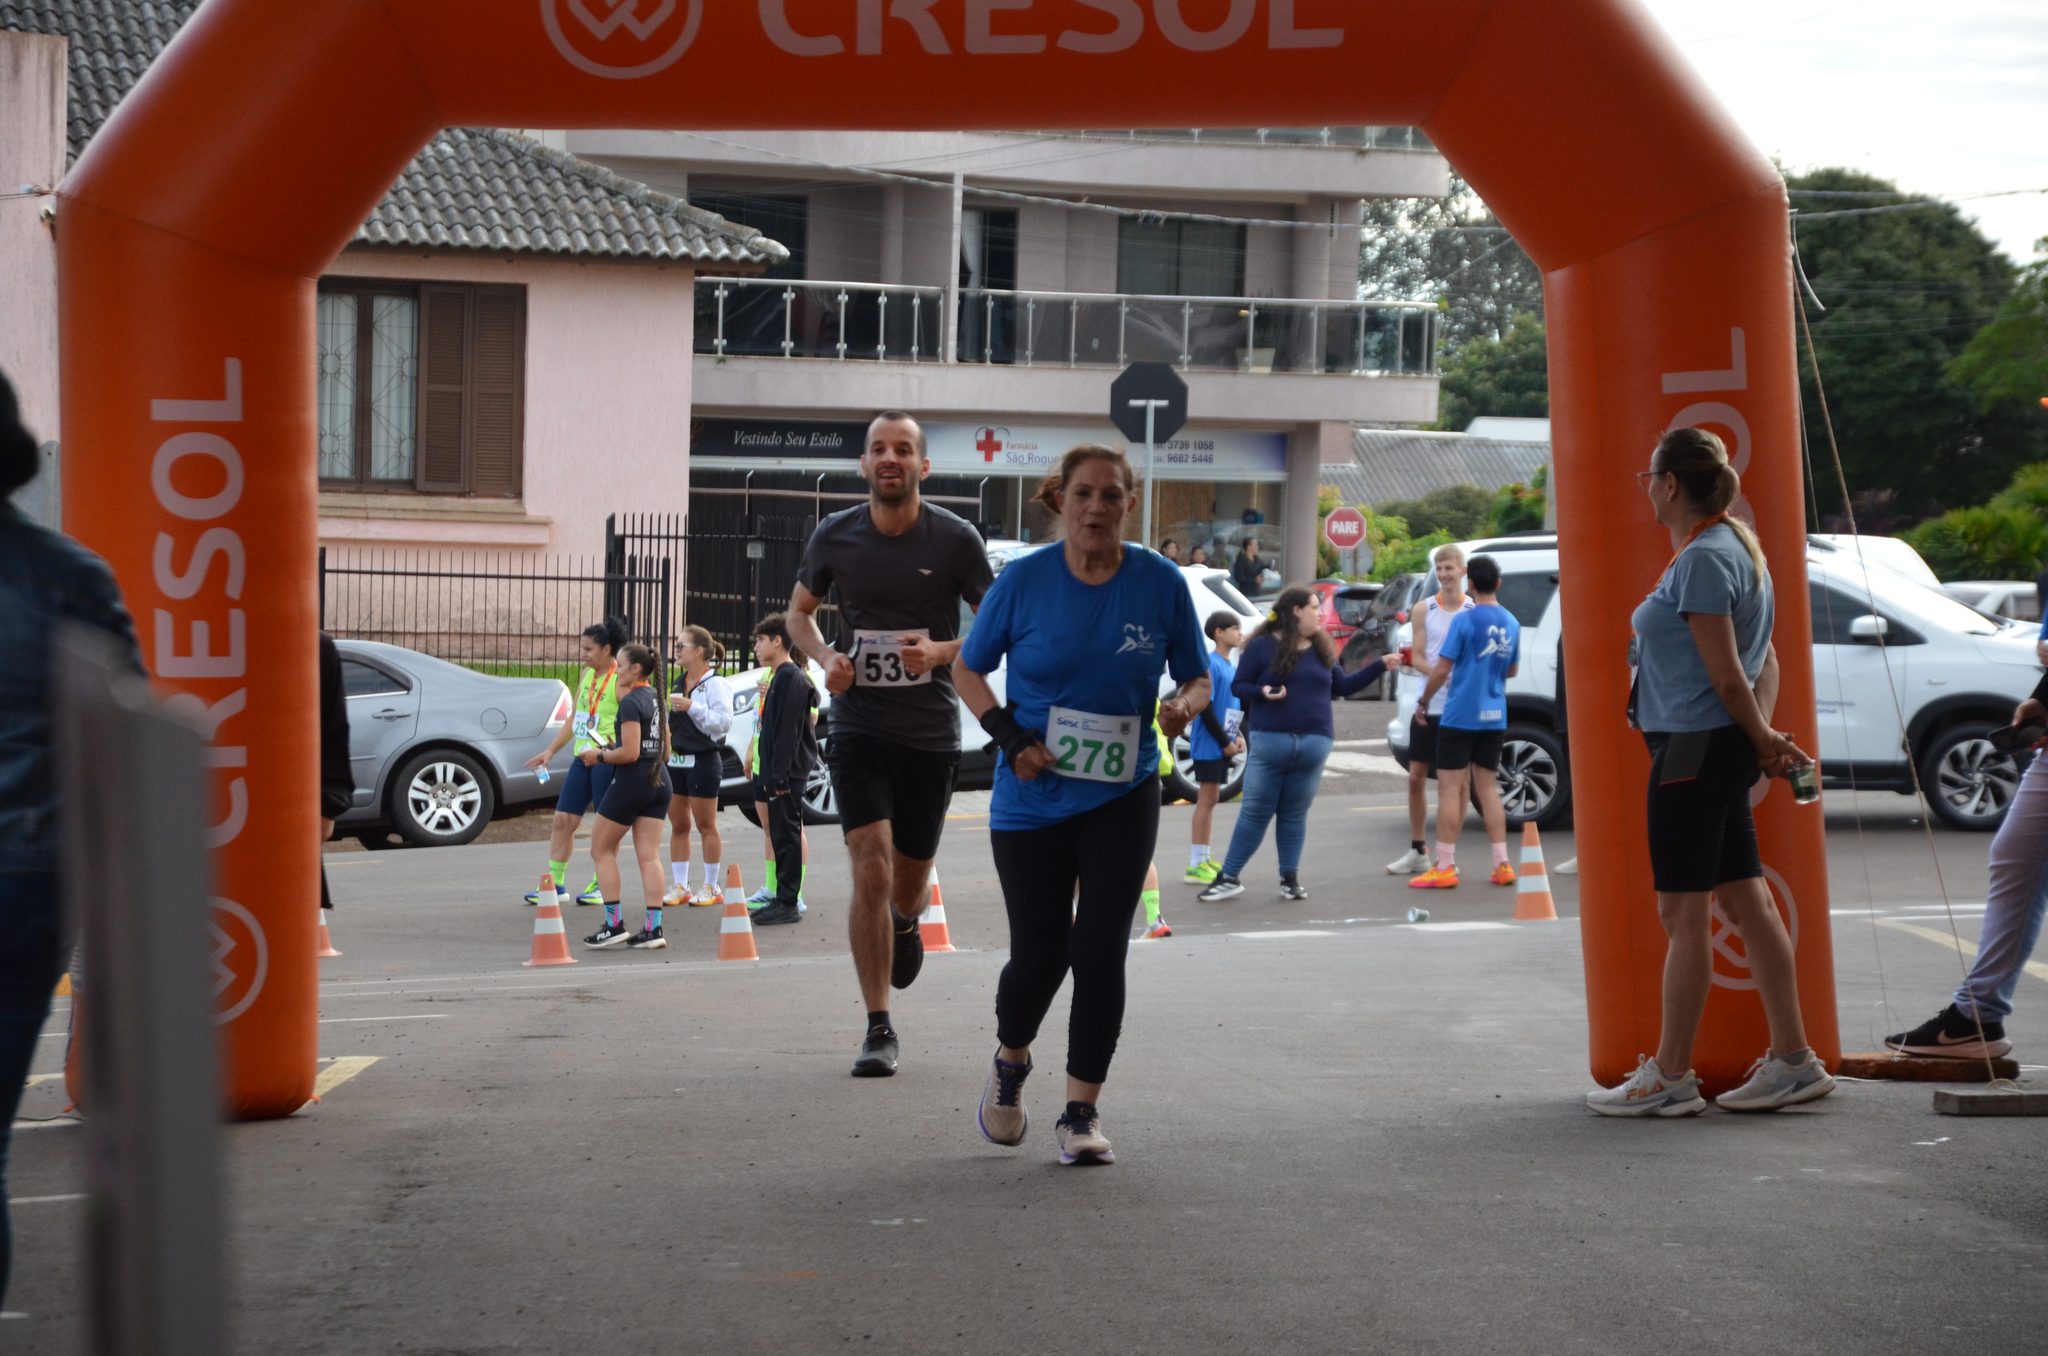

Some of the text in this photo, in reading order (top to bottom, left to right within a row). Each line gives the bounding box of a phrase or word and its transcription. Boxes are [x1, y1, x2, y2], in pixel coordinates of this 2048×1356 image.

[733, 430, 843, 447] Vestindo Seu Estilo
[1006, 440, 1038, 450] Farmácia
[1167, 440, 1190, 450] 3739
[1006, 451, 1025, 463] São
[1332, 520, 1360, 534] PARE
[1055, 735, 1126, 777] 278
[596, 930, 611, 941] FILA
[1626, 1080, 1665, 1101] FILA
